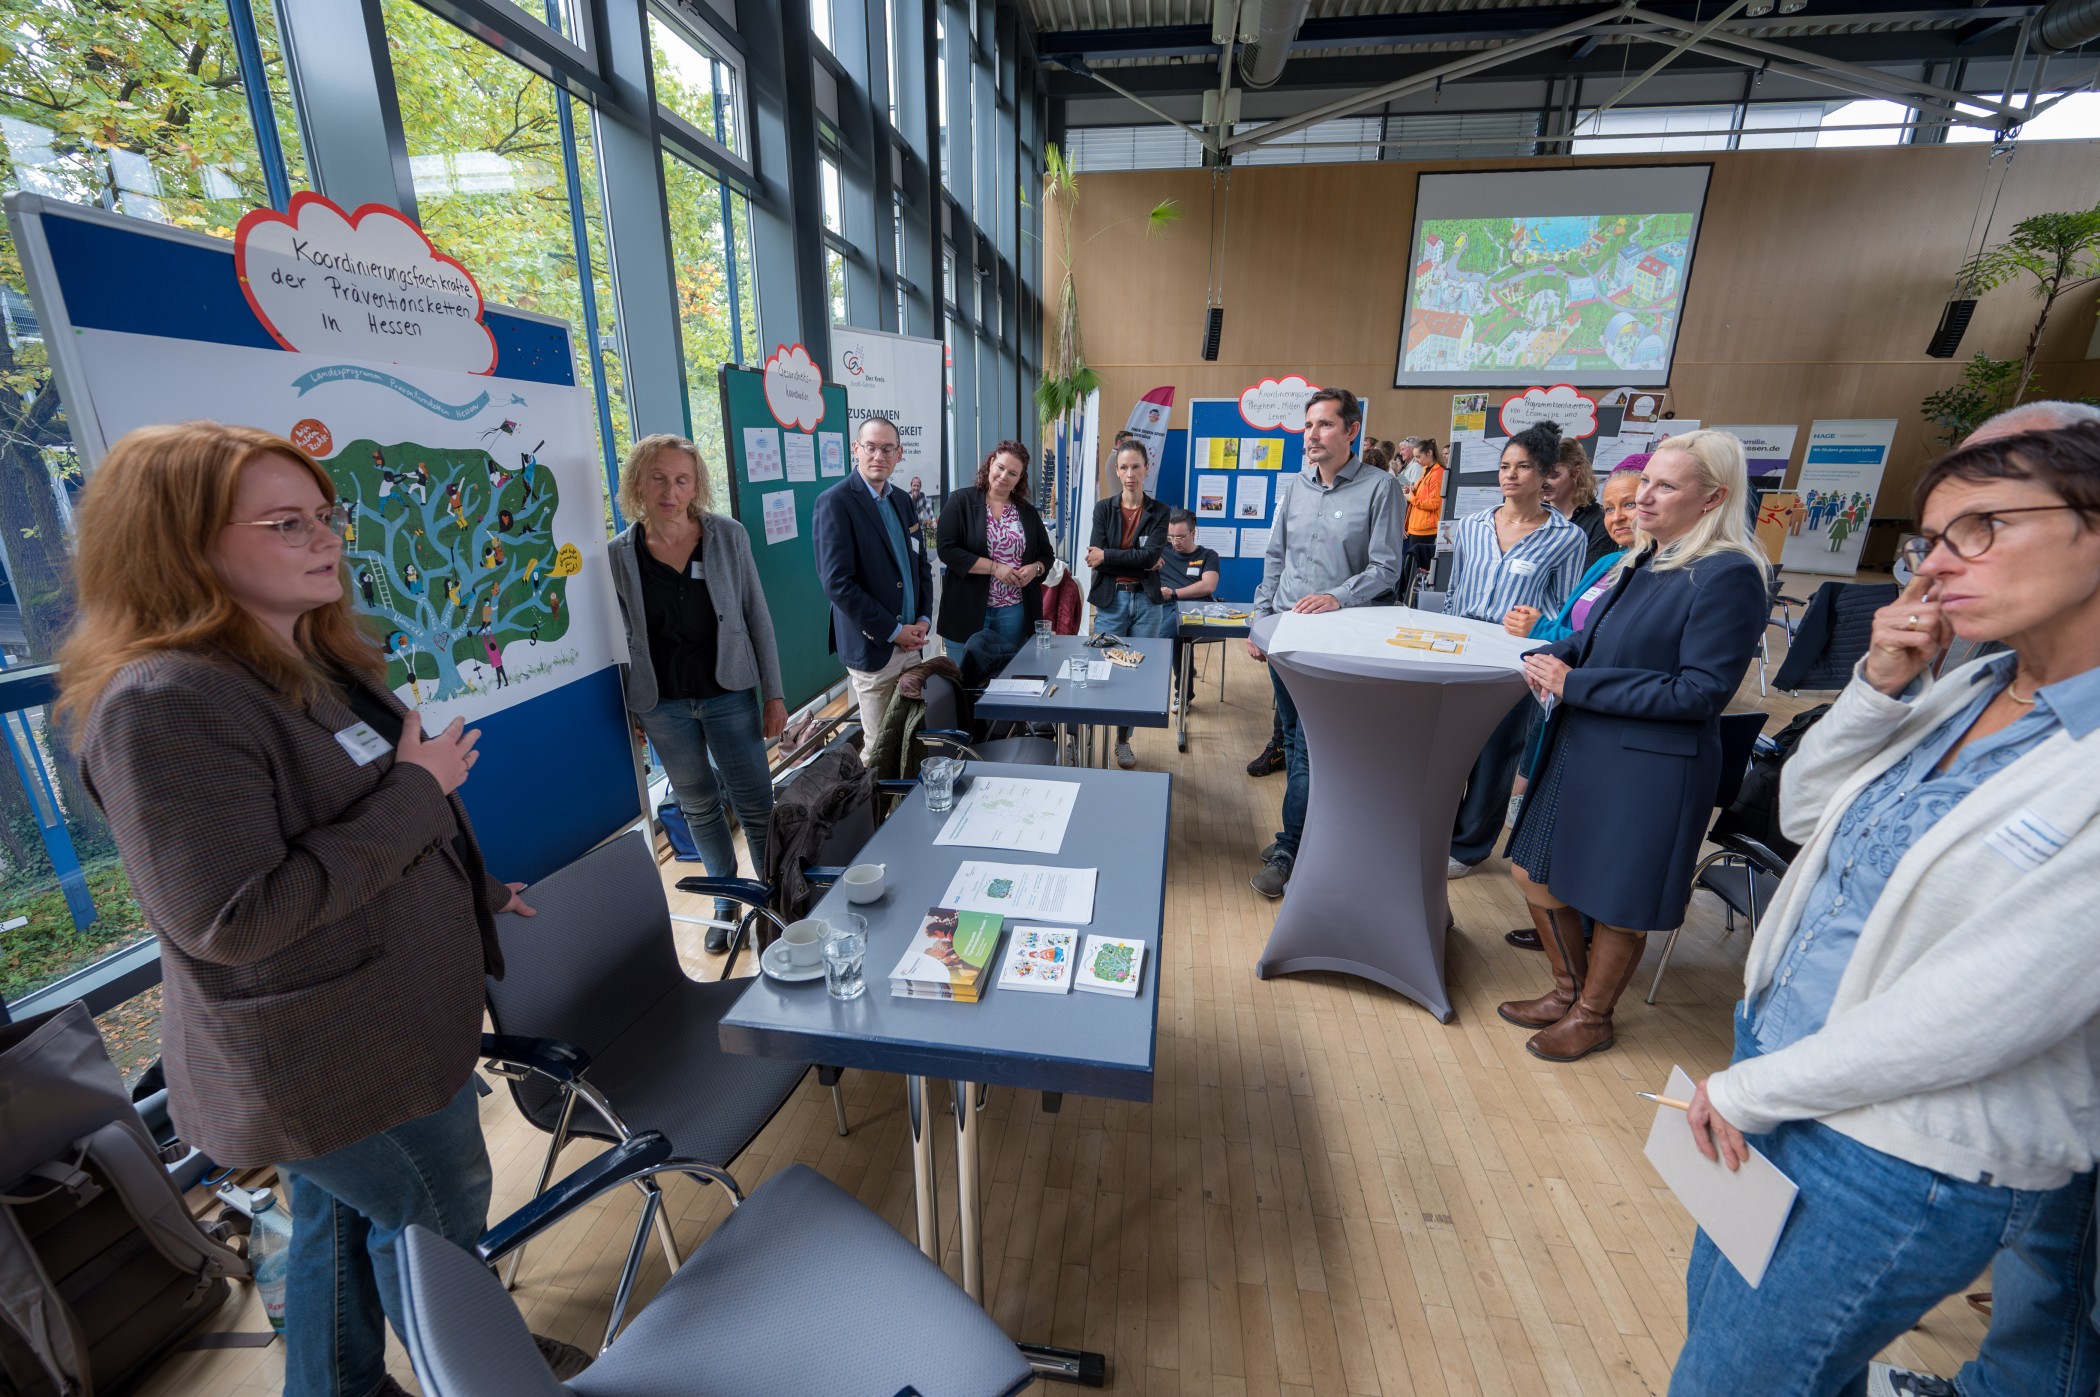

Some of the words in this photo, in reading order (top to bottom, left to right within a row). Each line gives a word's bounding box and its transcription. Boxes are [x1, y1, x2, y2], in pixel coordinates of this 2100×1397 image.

[271, 267, 306, 289] der
[324, 275, 470, 319] Präventionsketten
[367, 312, 422, 336] Hessen
[310, 368, 383, 383] Landesprogramm
[455, 403, 479, 418] Hessen
[848, 409, 900, 420] ZUSAMMEN
[295, 430, 320, 447] haben
[394, 612, 424, 637] Umwelt
